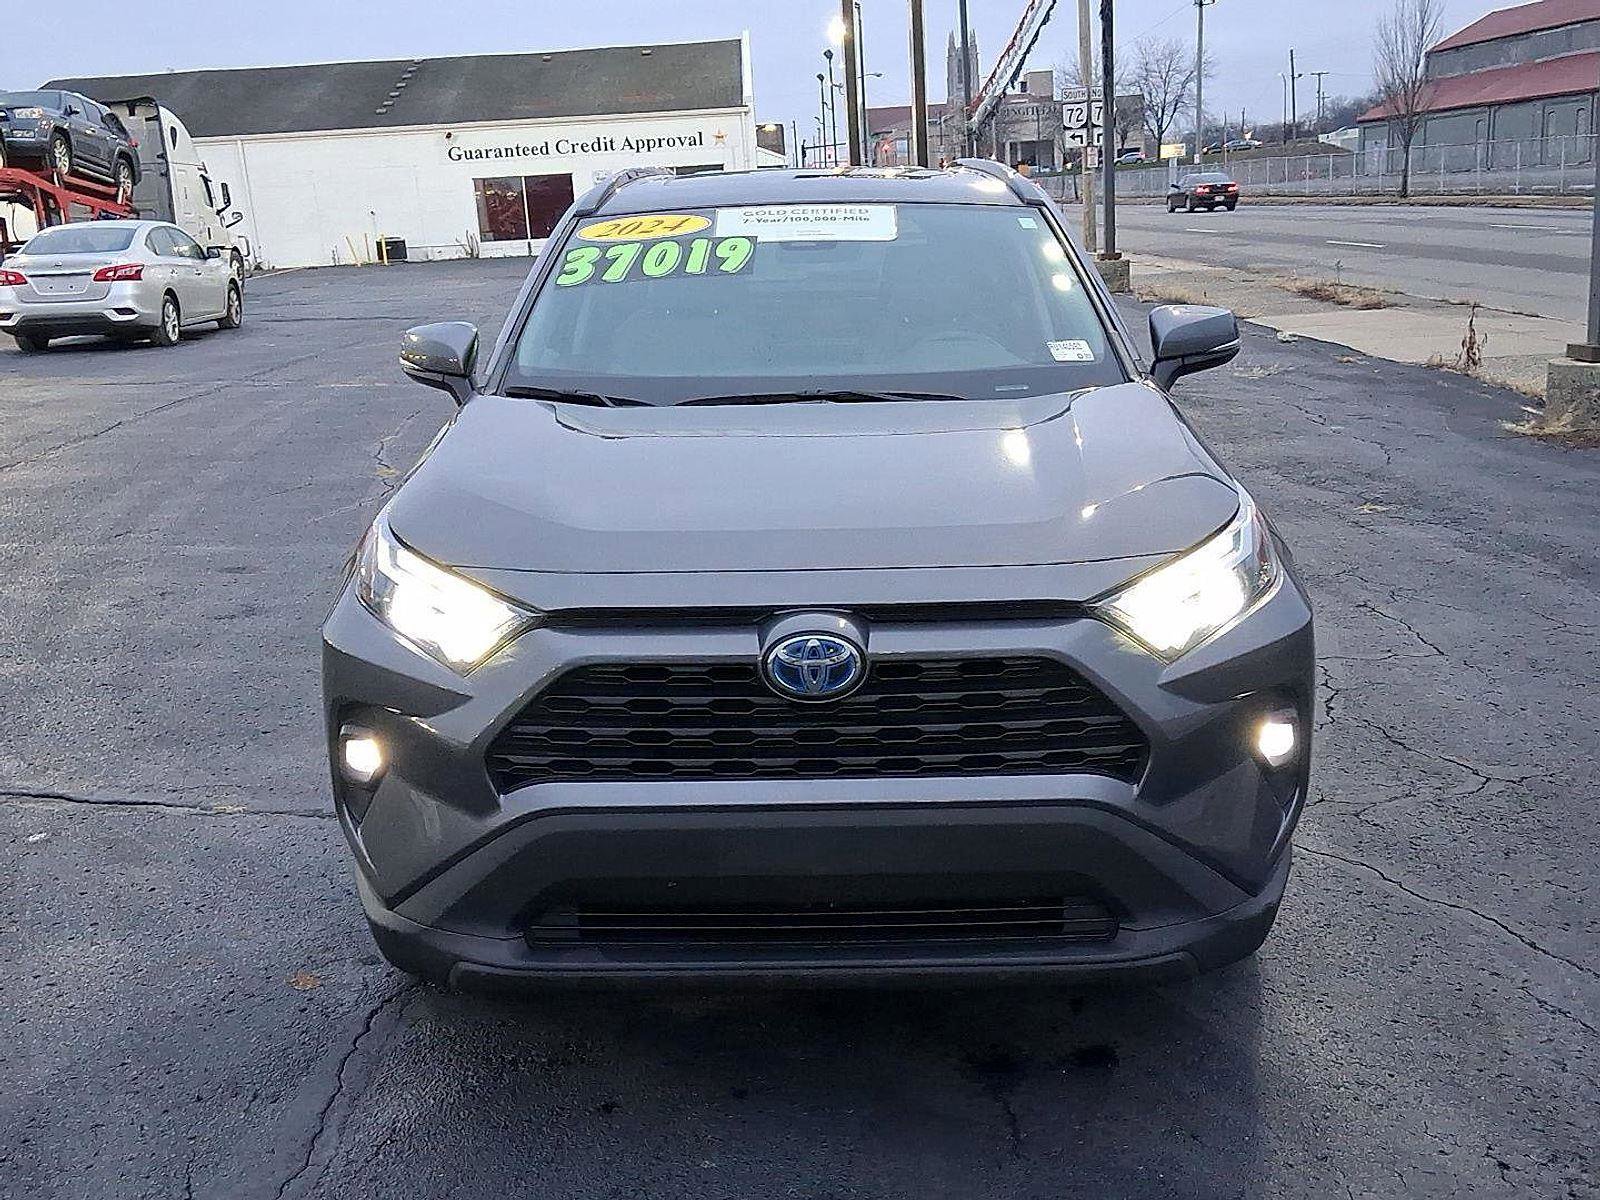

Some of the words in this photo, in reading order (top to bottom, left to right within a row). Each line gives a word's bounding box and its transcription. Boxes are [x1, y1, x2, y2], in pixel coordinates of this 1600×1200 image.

[1063, 91, 1085, 99] SOUTH
[1066, 107, 1084, 123] 72
[1094, 106, 1103, 121] 7
[448, 141, 550, 162] Guaranteed
[555, 136, 616, 155] Credit
[620, 131, 704, 152] Approval
[743, 209, 787, 217] GOLD
[598, 217, 690, 237] 2024
[555, 236, 755, 288] 37019
